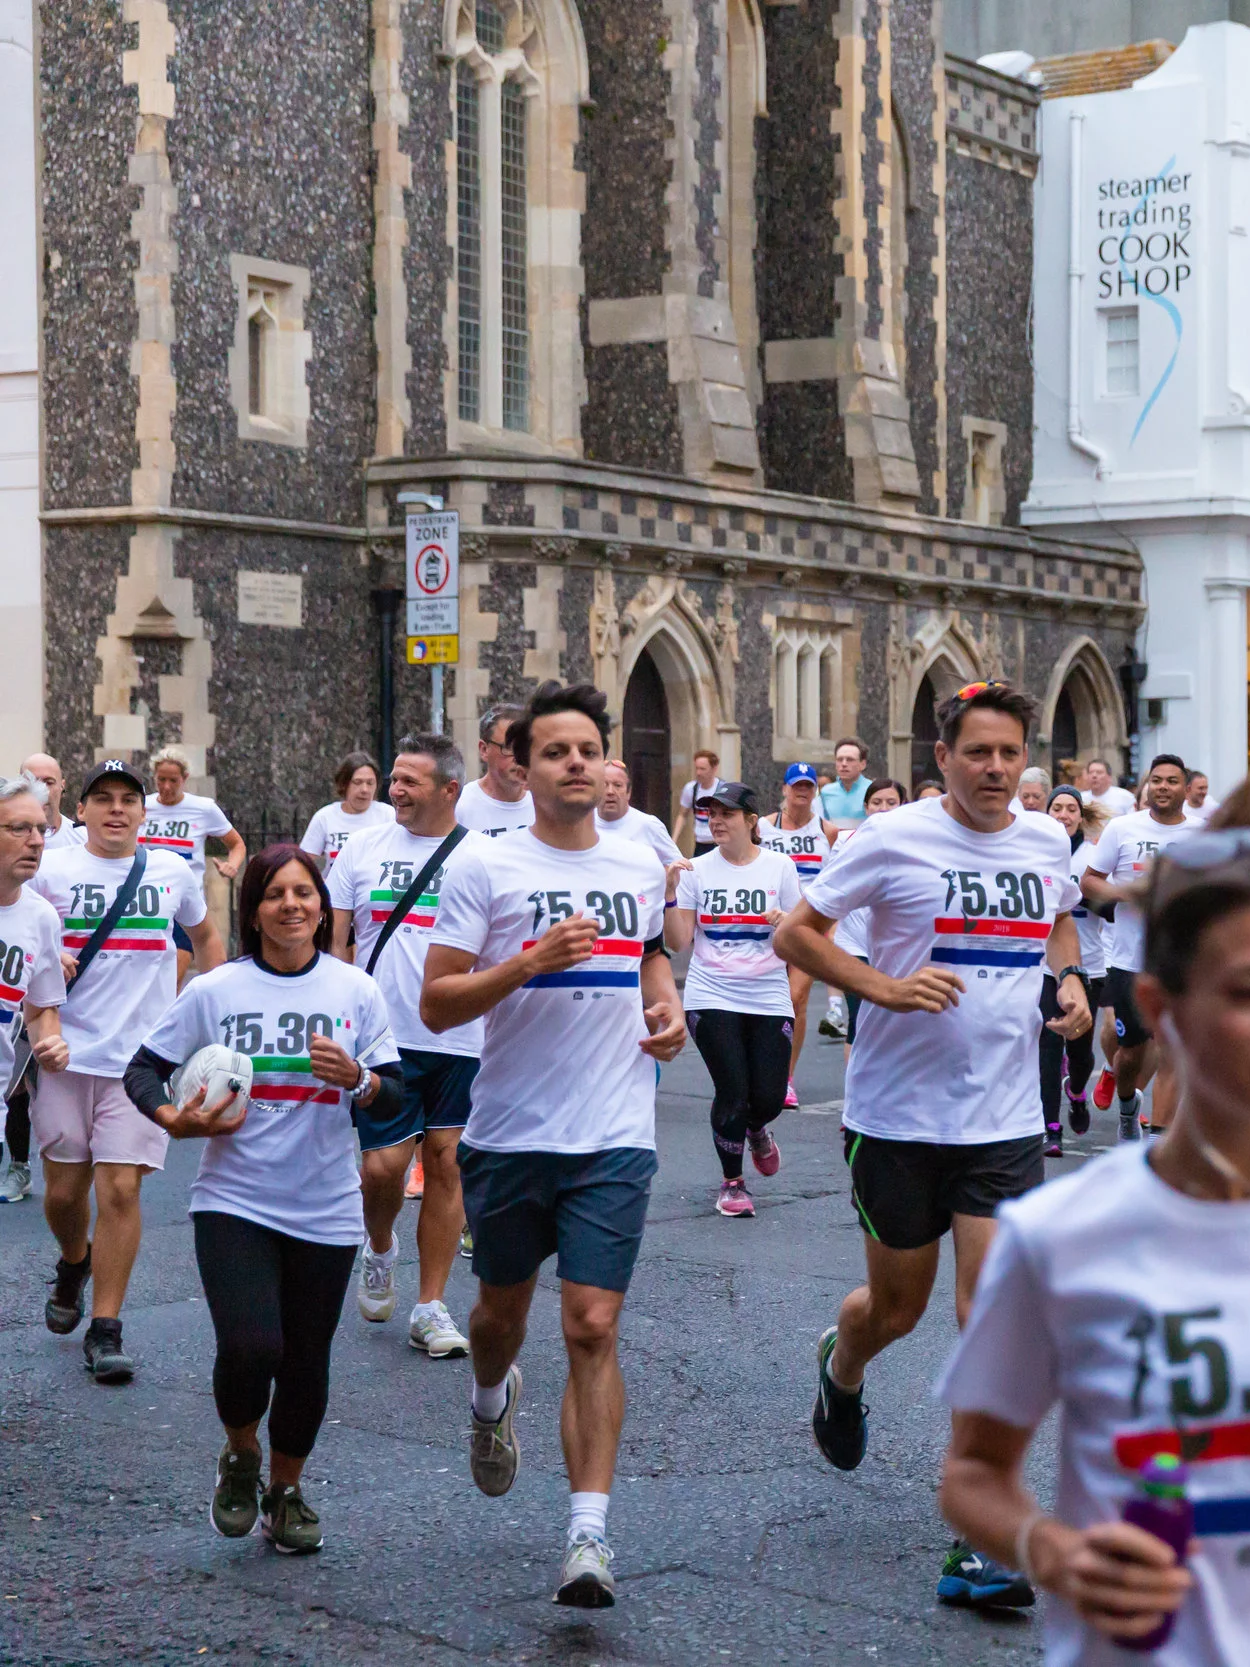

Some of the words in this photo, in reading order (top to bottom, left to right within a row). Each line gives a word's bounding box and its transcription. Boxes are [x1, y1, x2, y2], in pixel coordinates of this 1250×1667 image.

[1098, 173, 1192, 200] steamer
[1098, 200, 1192, 230] trading
[1098, 231, 1190, 265] COOK
[1099, 264, 1191, 299] SHOP
[409, 516, 456, 526] PEDESTRIAN
[416, 526, 448, 541] ZONE
[146, 820, 189, 839] 5.30
[84, 883, 161, 918] 530
[711, 888, 767, 914] 5.30
[957, 871, 1045, 920] 5.30
[545, 890, 639, 937] 530
[235, 1012, 333, 1055] 5.30
